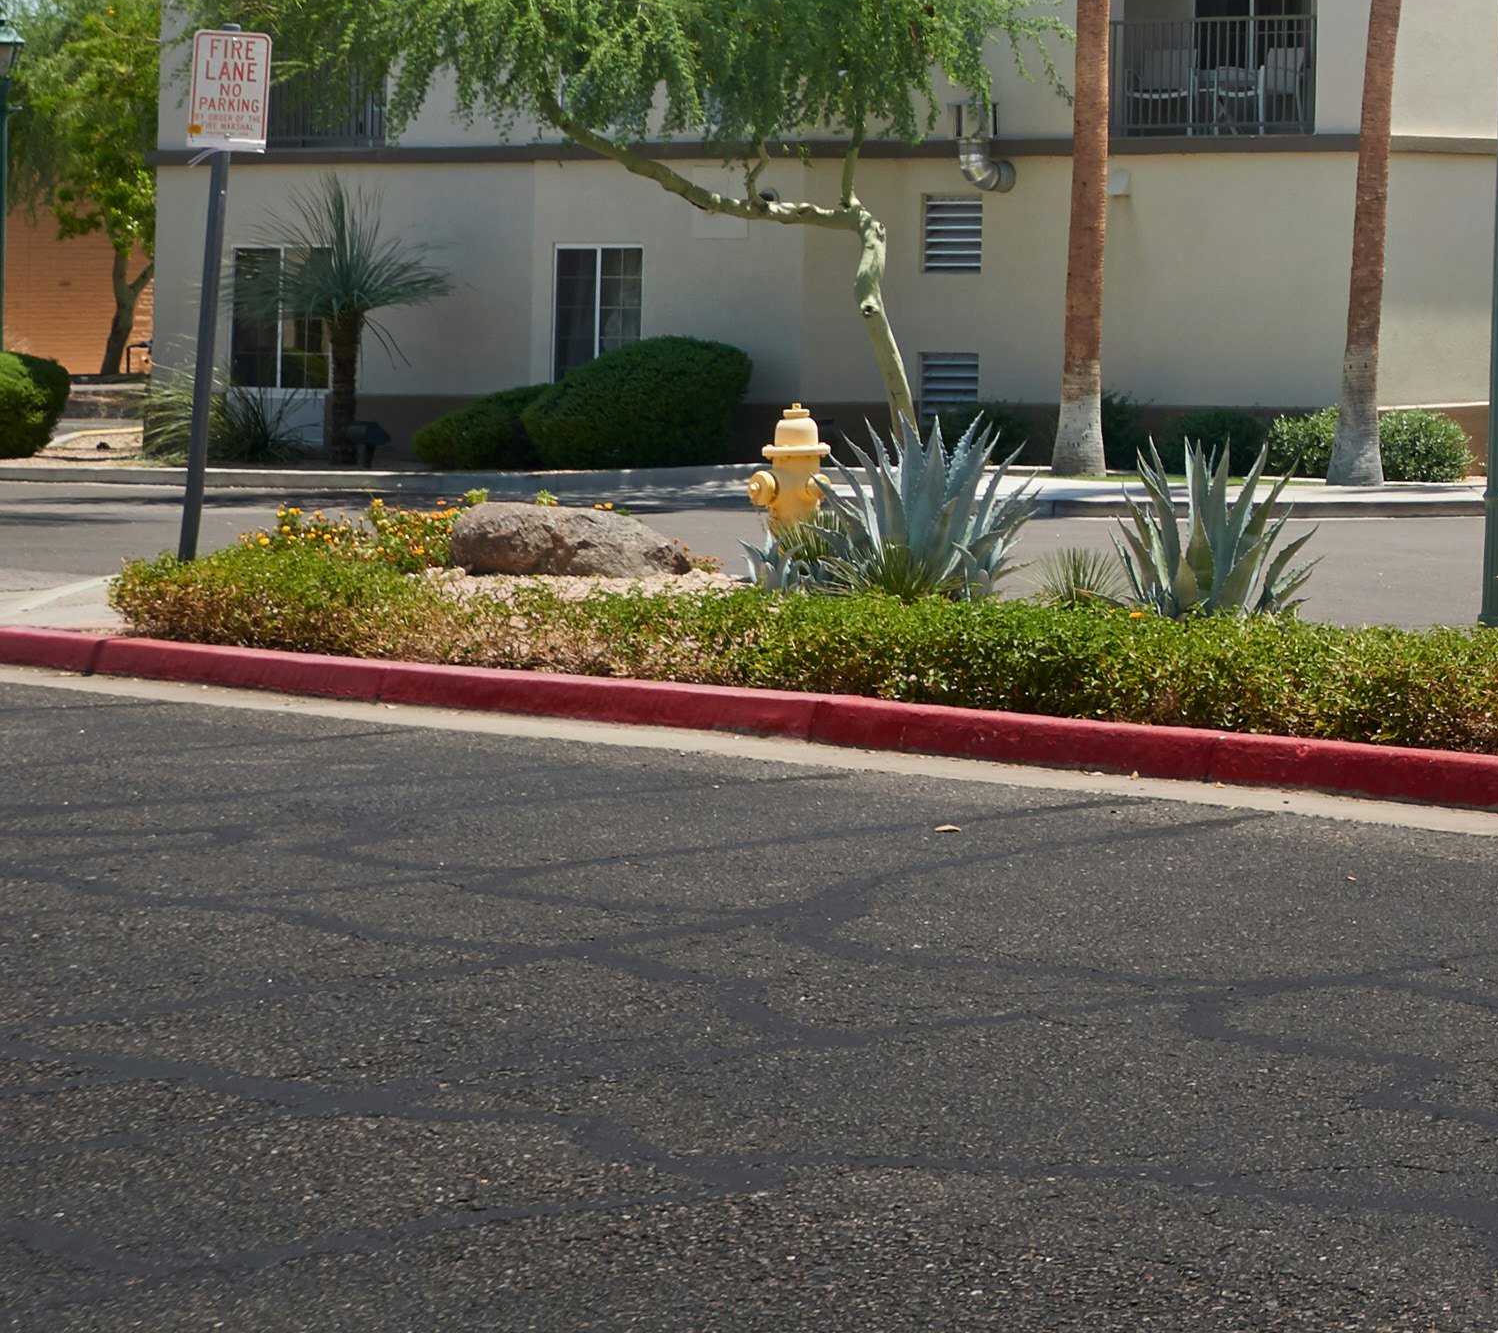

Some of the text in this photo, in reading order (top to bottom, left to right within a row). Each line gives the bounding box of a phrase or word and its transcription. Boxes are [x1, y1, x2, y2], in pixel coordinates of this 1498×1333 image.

[210, 38, 256, 60] FIRE
[205, 60, 258, 82] LANE
[219, 82, 243, 97] NO
[198, 96, 260, 113] PARKING
[208, 113, 233, 122] ORDER
[249, 115, 262, 123] THE
[220, 122, 254, 132] MARSHAL
